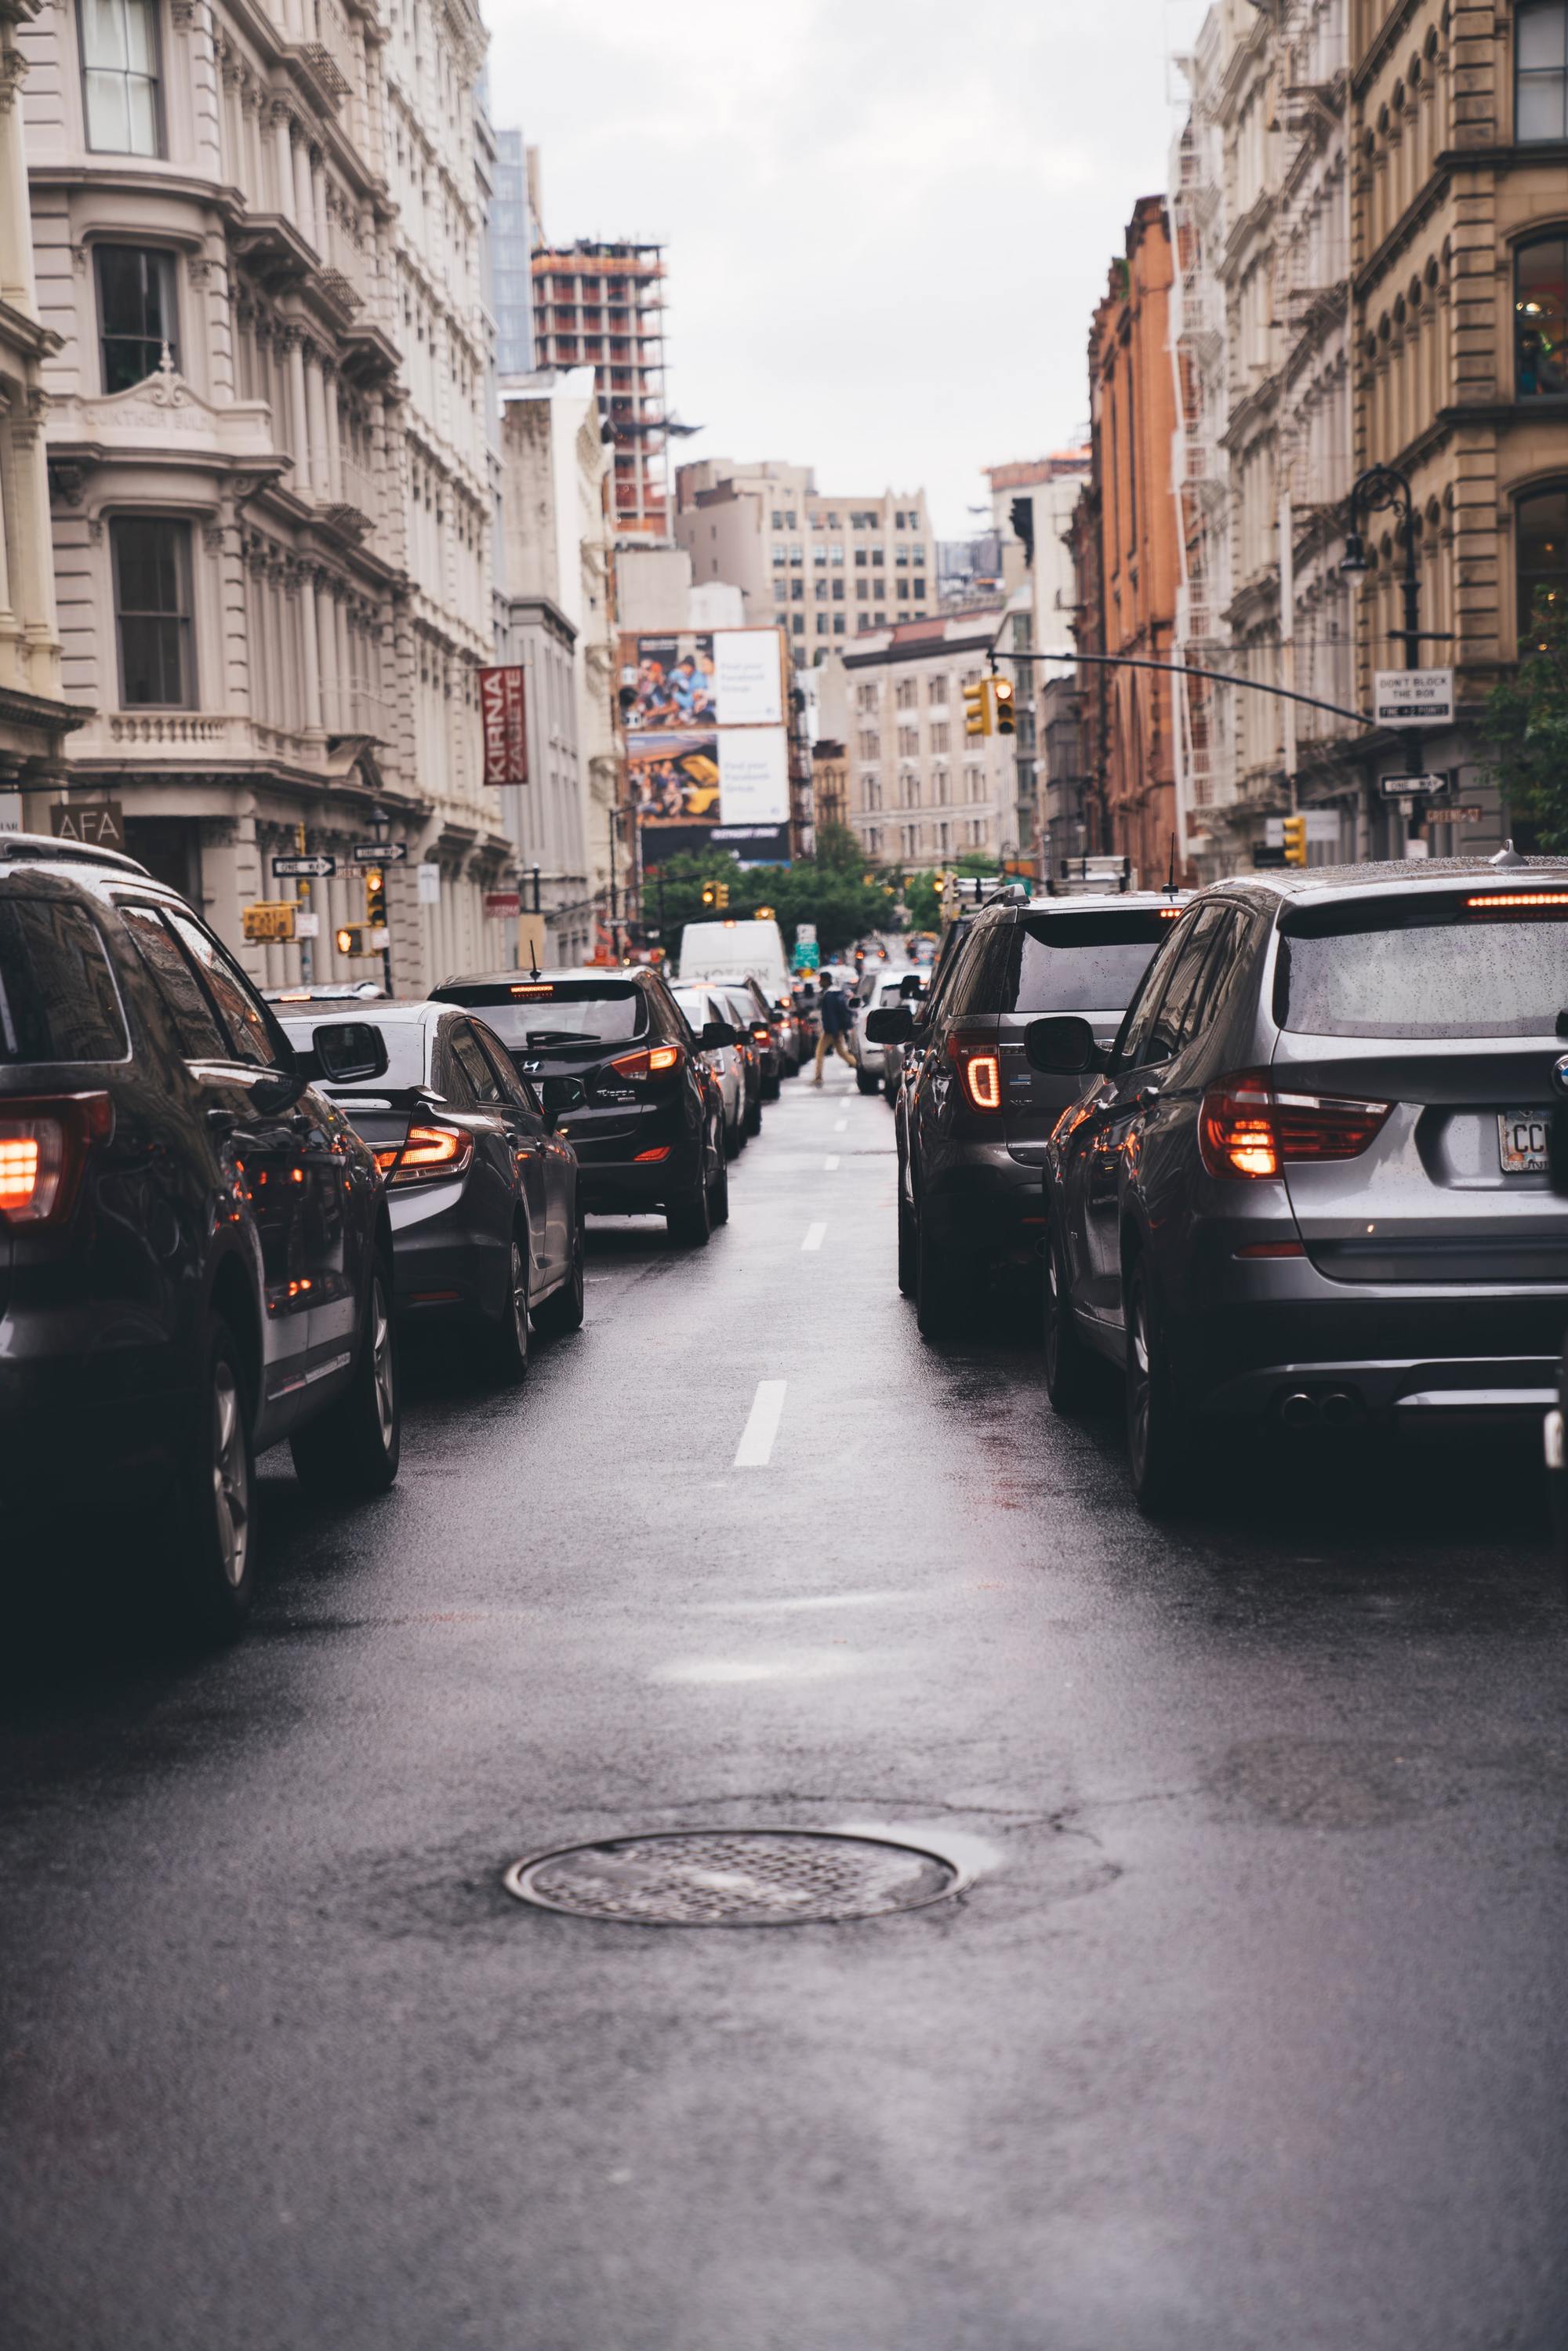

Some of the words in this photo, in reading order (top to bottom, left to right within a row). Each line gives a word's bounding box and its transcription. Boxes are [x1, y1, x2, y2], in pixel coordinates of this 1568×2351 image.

[1414, 677, 1447, 687] BLOCK
[1393, 689, 1411, 699] THE
[1416, 689, 1436, 699] BOX
[484, 670, 506, 783] KIRNA
[1392, 781, 1409, 790] ONE
[1418, 779, 1439, 789] WAY
[60, 812, 119, 841] AFA
[281, 863, 299, 873] ONE
[308, 863, 325, 873] WAY
